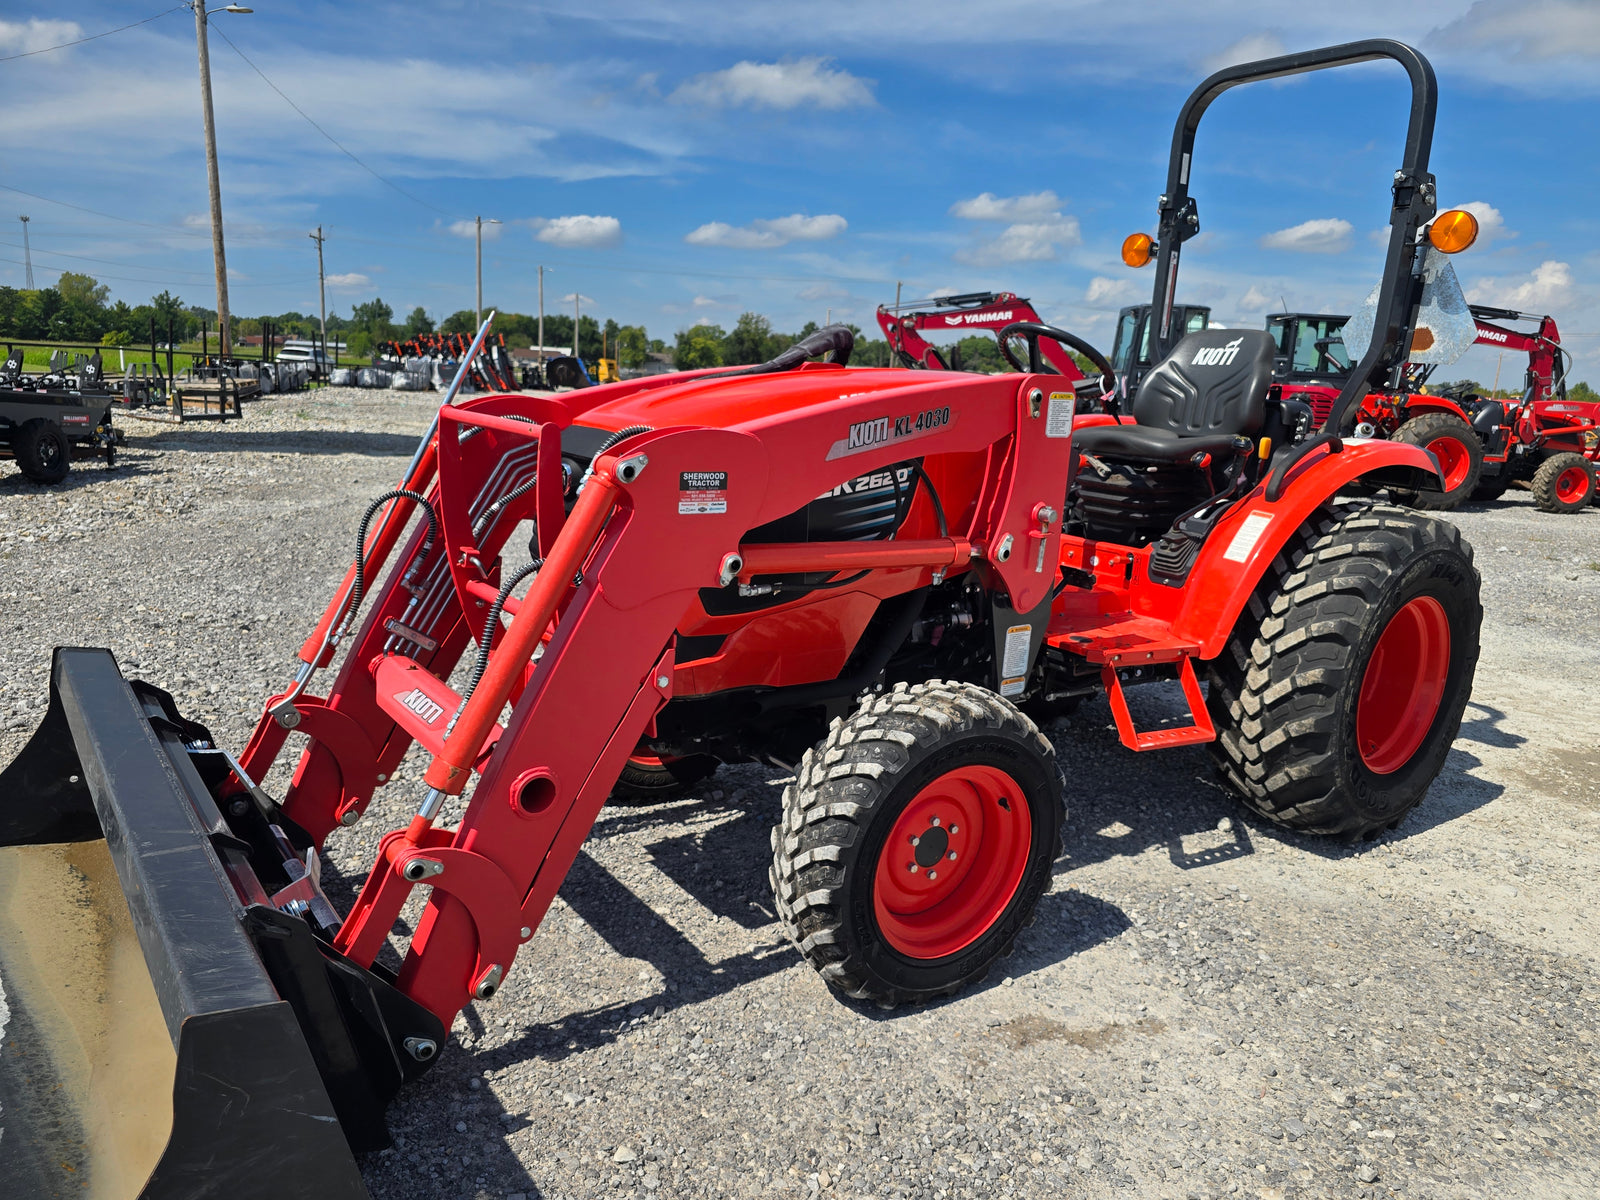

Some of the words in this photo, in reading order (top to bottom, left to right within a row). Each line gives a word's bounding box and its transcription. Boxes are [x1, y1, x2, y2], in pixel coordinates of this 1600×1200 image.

[964, 310, 1013, 324] YANMAR
[1191, 344, 1241, 366] KIOTI
[848, 416, 889, 449] KIOTI
[895, 416, 912, 437] KL
[915, 406, 950, 432] 4030
[683, 472, 724, 480] SHERWOOD
[815, 468, 908, 500] K2620
[403, 688, 445, 725] KIOTI
